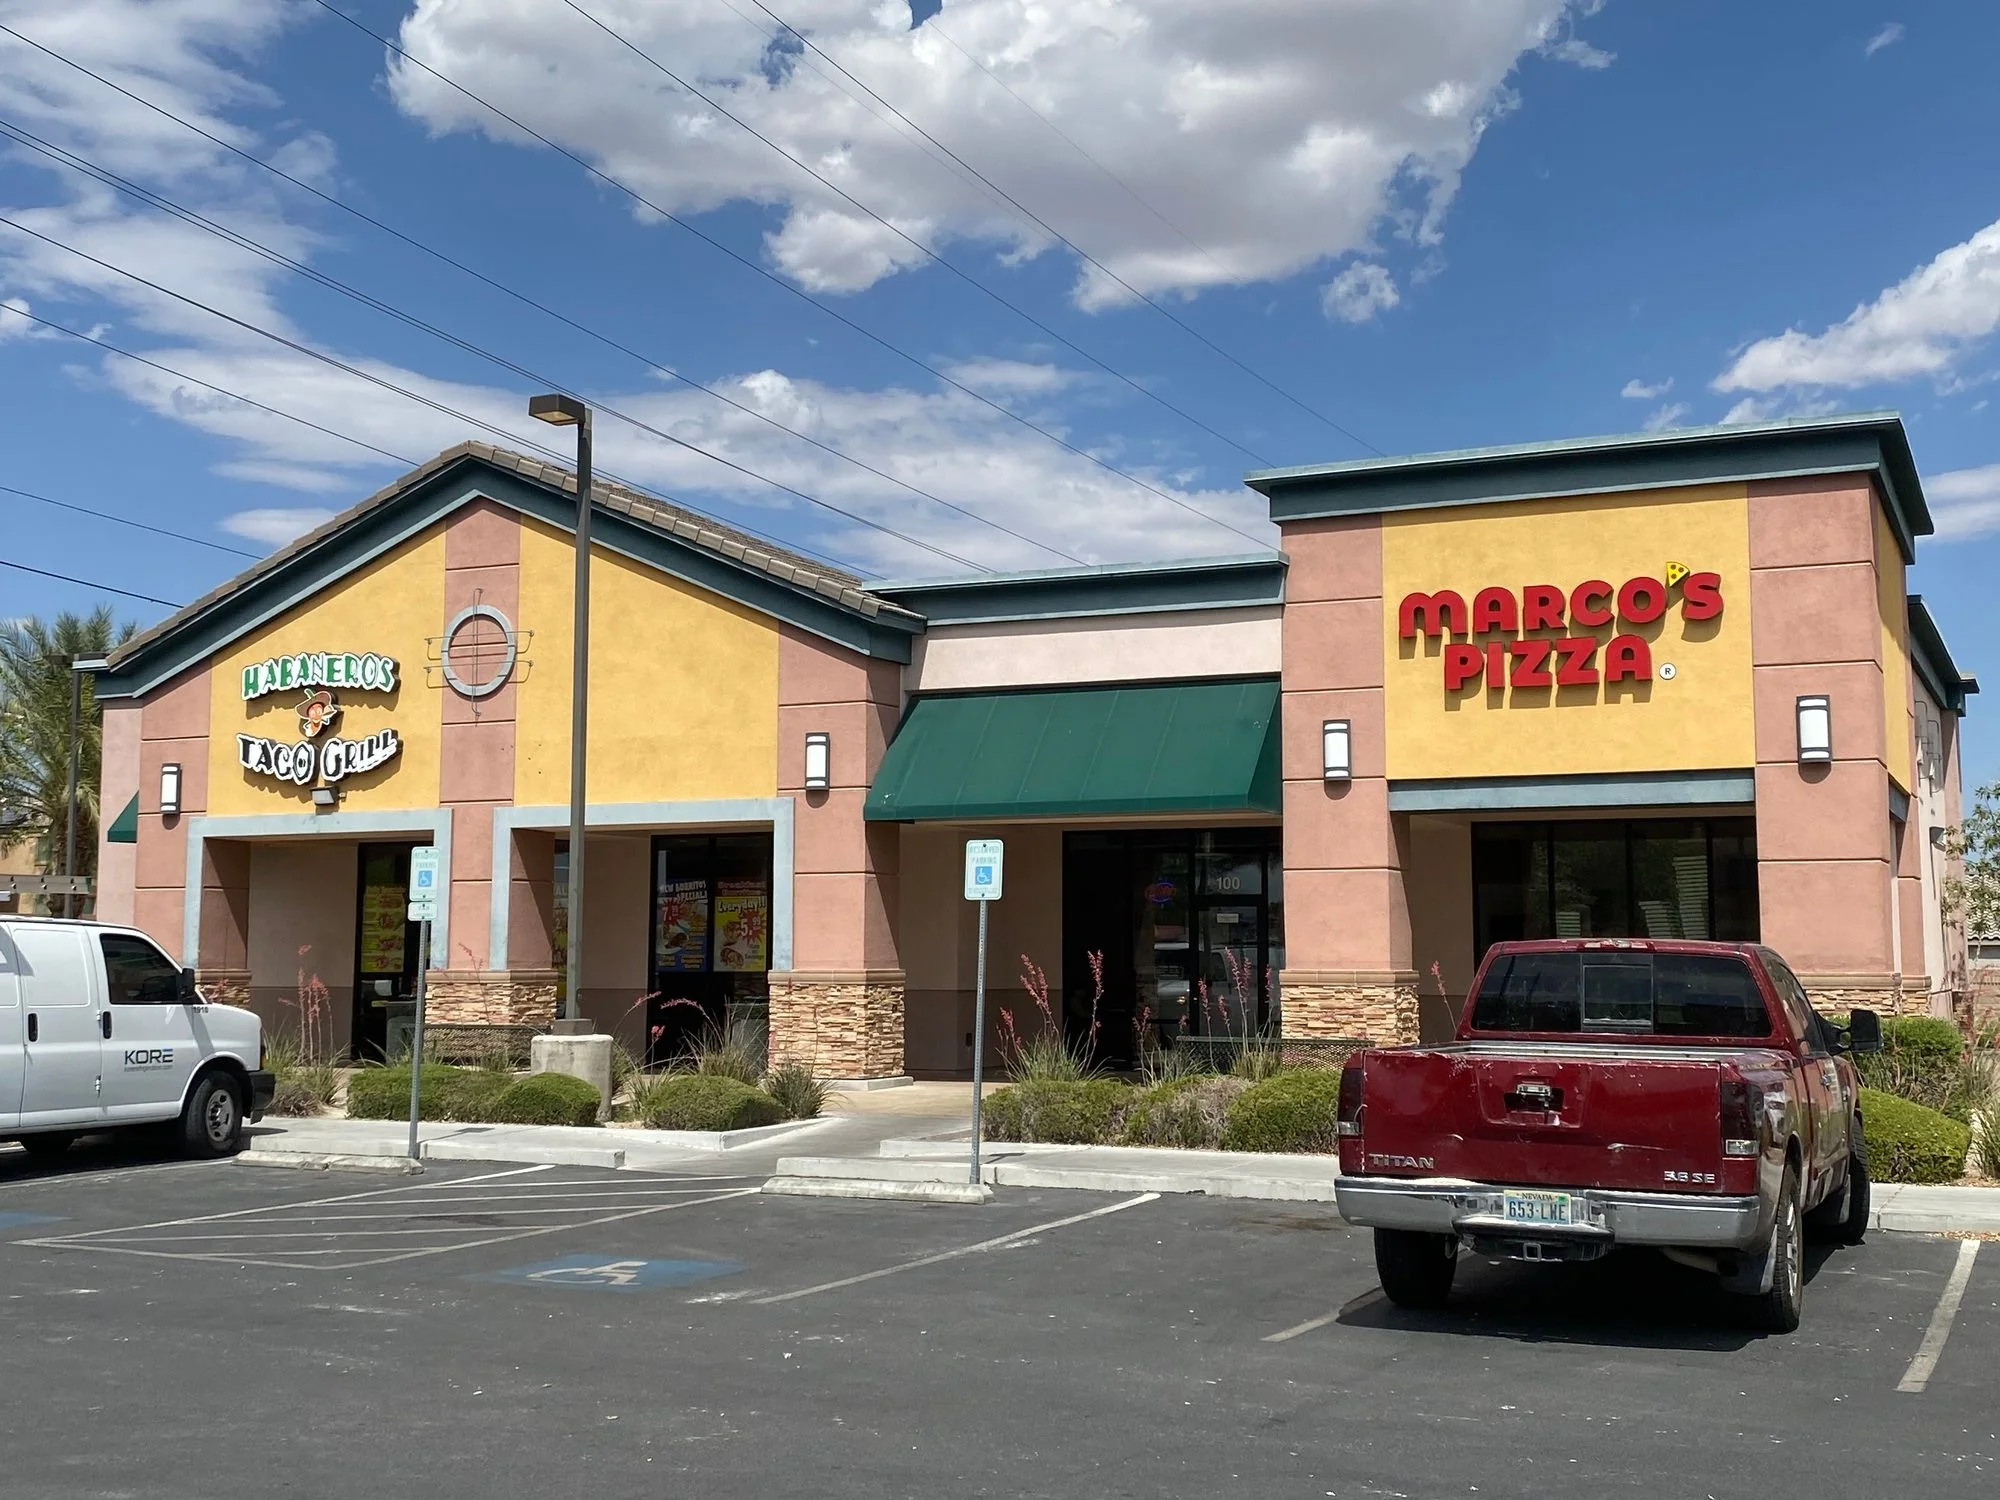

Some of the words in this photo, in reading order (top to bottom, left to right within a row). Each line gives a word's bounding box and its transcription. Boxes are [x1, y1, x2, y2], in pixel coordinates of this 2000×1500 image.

[1399, 562, 1724, 639] MARCO'S
[1444, 634, 1654, 691] PIZZA
[242, 653, 395, 699] HABANEROS
[237, 734, 315, 784] TACO
[321, 729, 397, 781] GRILL
[1215, 876, 1241, 890] 100
[124, 1048, 174, 1065] KORE
[1368, 1153, 1435, 1170] TITAN
[1692, 1172, 1716, 1184] SE
[1520, 1192, 1553, 1202] NEVADA
